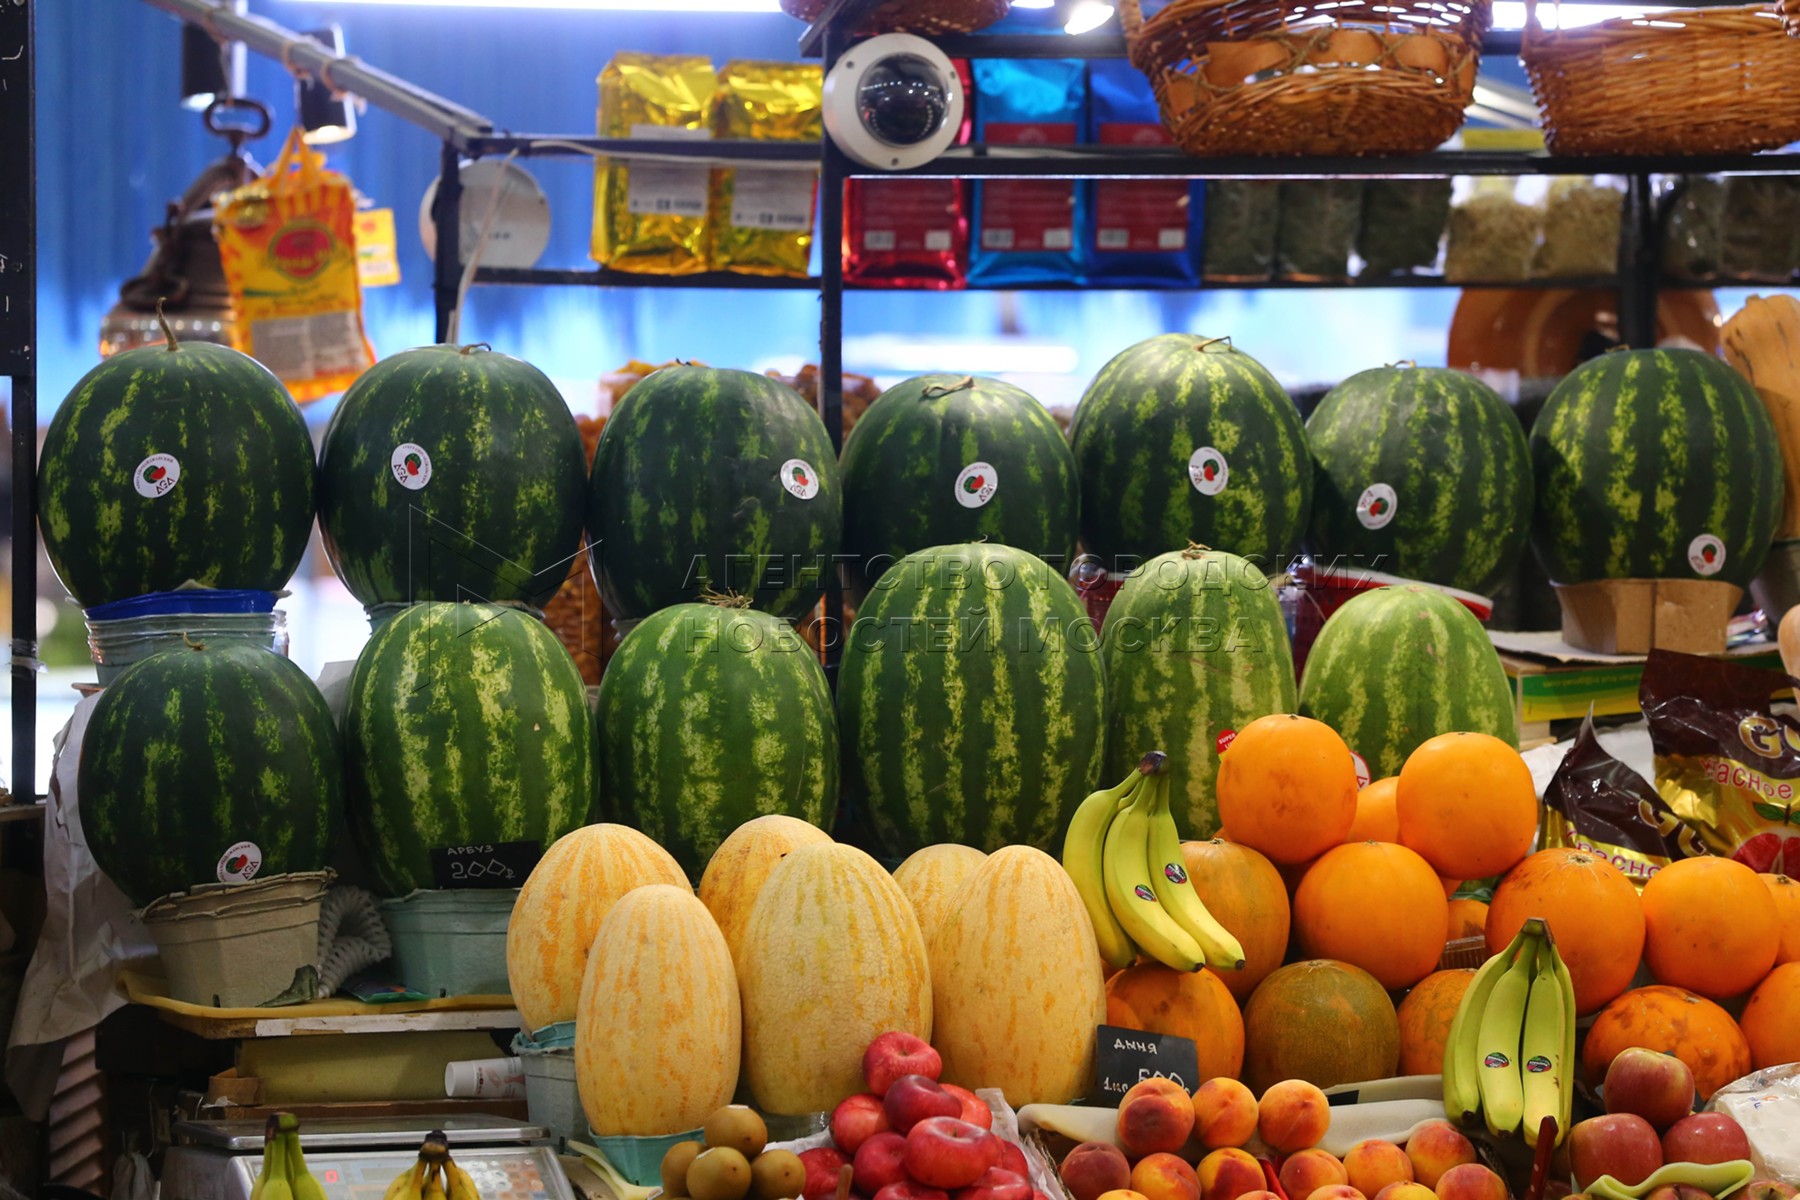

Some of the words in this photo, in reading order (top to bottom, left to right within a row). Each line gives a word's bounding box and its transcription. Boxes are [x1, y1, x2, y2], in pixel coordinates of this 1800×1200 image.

[155, 477, 176, 495] AGA
[447, 844, 494, 856] АРБУЗ
[242, 860, 259, 879] AGA
